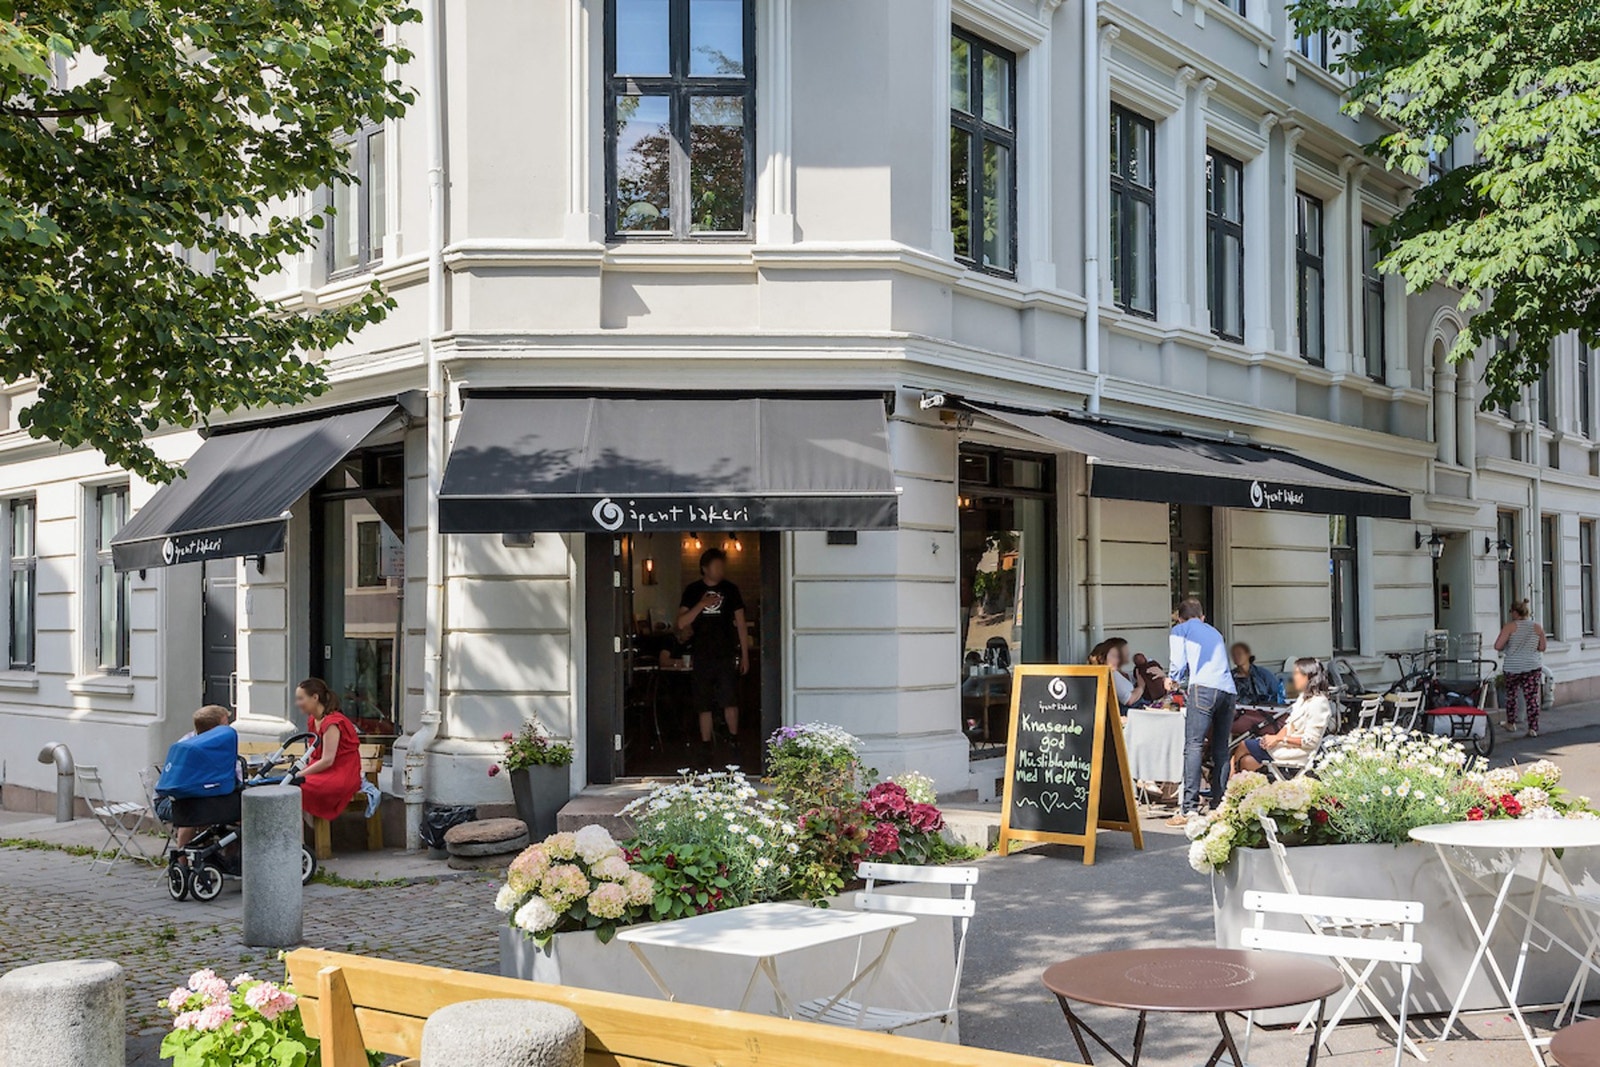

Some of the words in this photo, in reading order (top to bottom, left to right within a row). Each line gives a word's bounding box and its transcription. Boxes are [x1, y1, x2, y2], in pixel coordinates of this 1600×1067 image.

[689, 505, 748, 524] bakeri
[1022, 712, 1083, 735] Knasende
[1039, 733, 1065, 752] god
